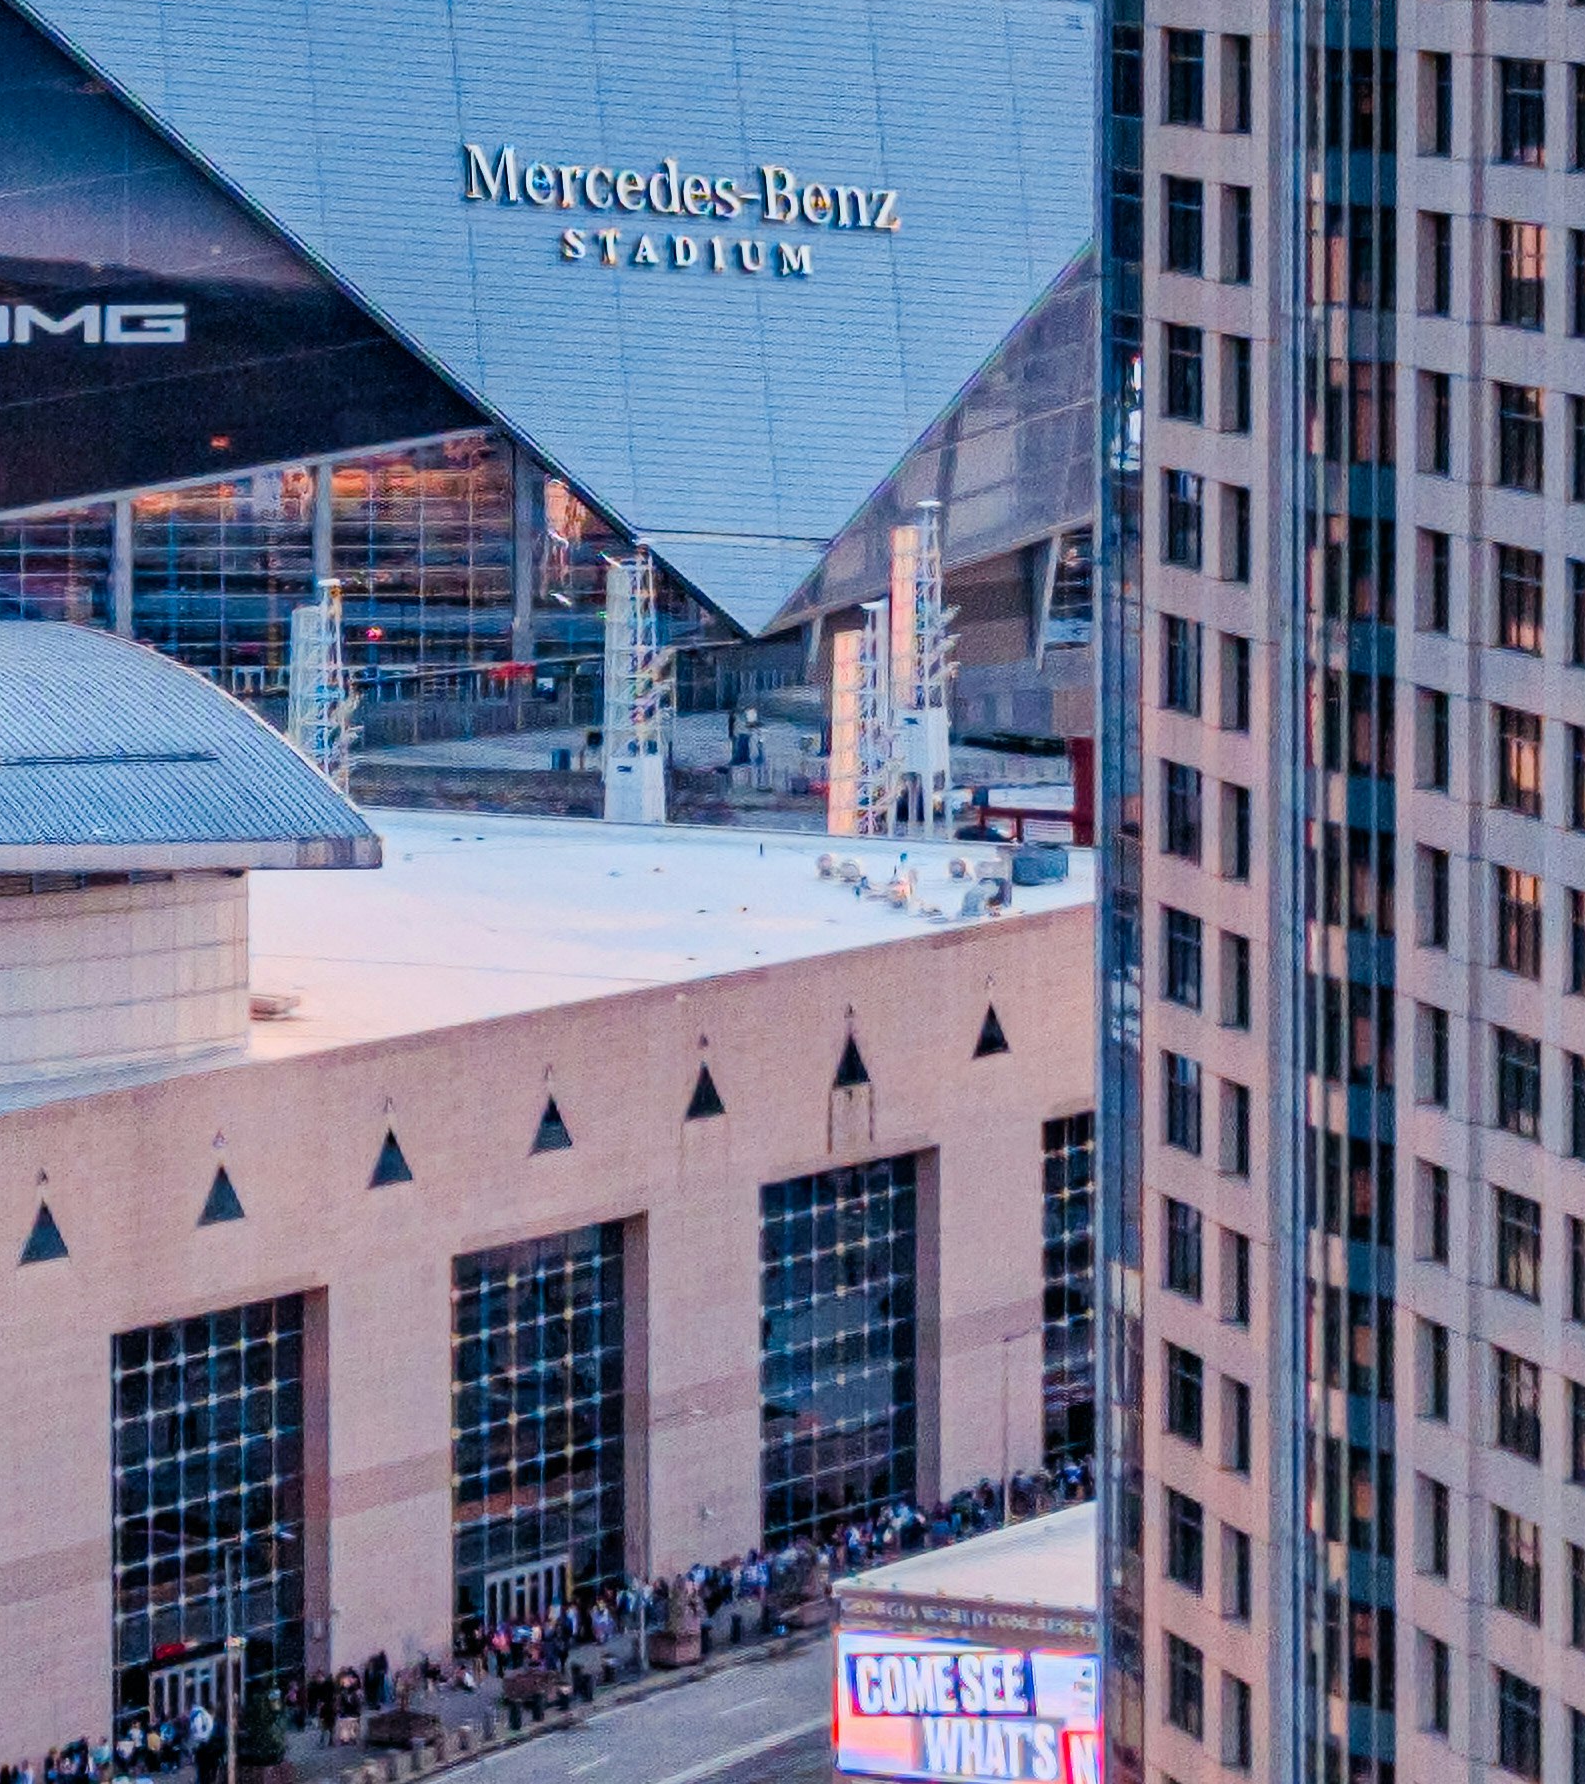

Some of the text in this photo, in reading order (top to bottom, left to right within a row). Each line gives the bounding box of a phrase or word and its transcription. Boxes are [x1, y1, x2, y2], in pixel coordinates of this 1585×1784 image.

[463, 142, 902, 232] Mercedes-Benz
[561, 227, 813, 276] STADIUM
[855, 1654, 1028, 1714] COME SEE
